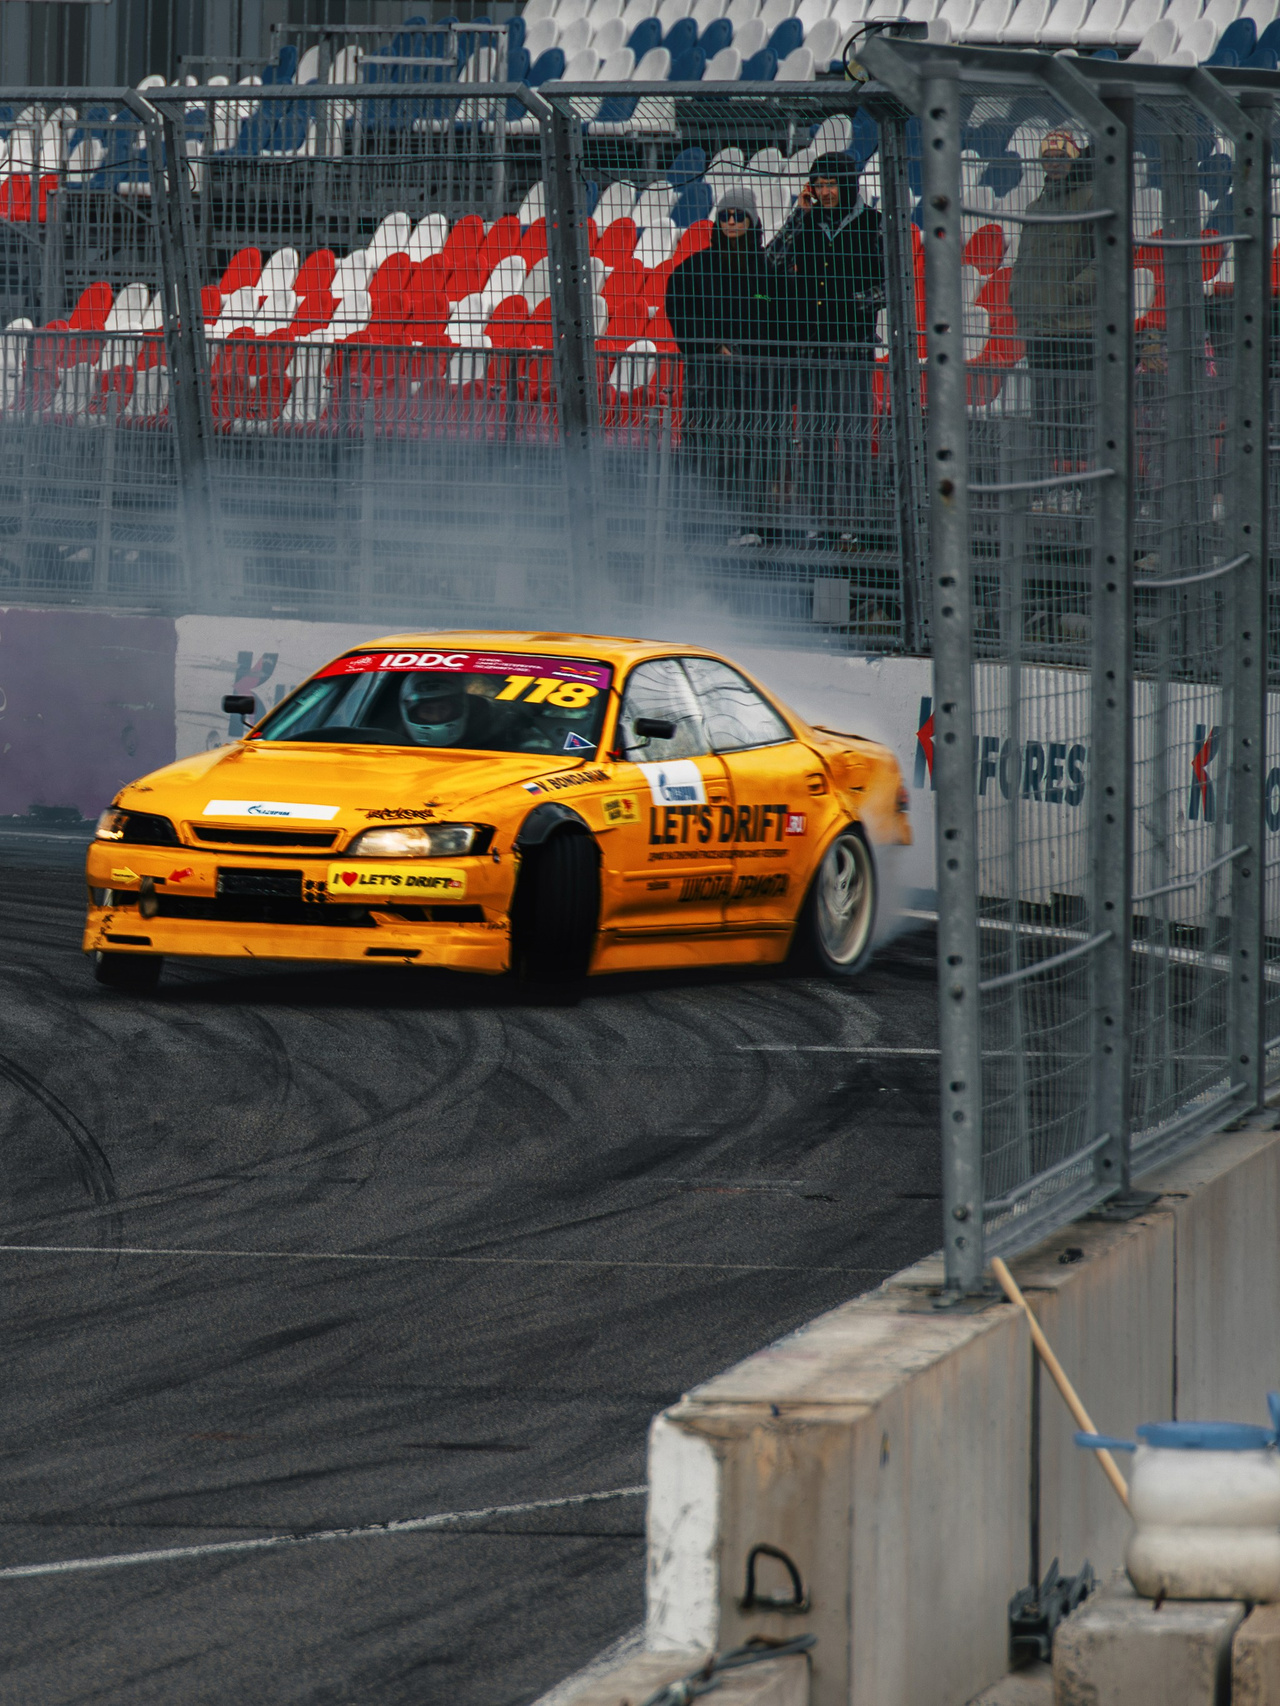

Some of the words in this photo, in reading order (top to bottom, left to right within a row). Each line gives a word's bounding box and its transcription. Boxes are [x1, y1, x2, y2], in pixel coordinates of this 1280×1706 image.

[380, 653, 470, 668] IDDC
[494, 675, 599, 709] 118
[649, 805, 713, 844] LET'S
[718, 804, 789, 842] DRIFT
[359, 874, 403, 886] LET'S
[405, 876, 451, 888] DRIFT
